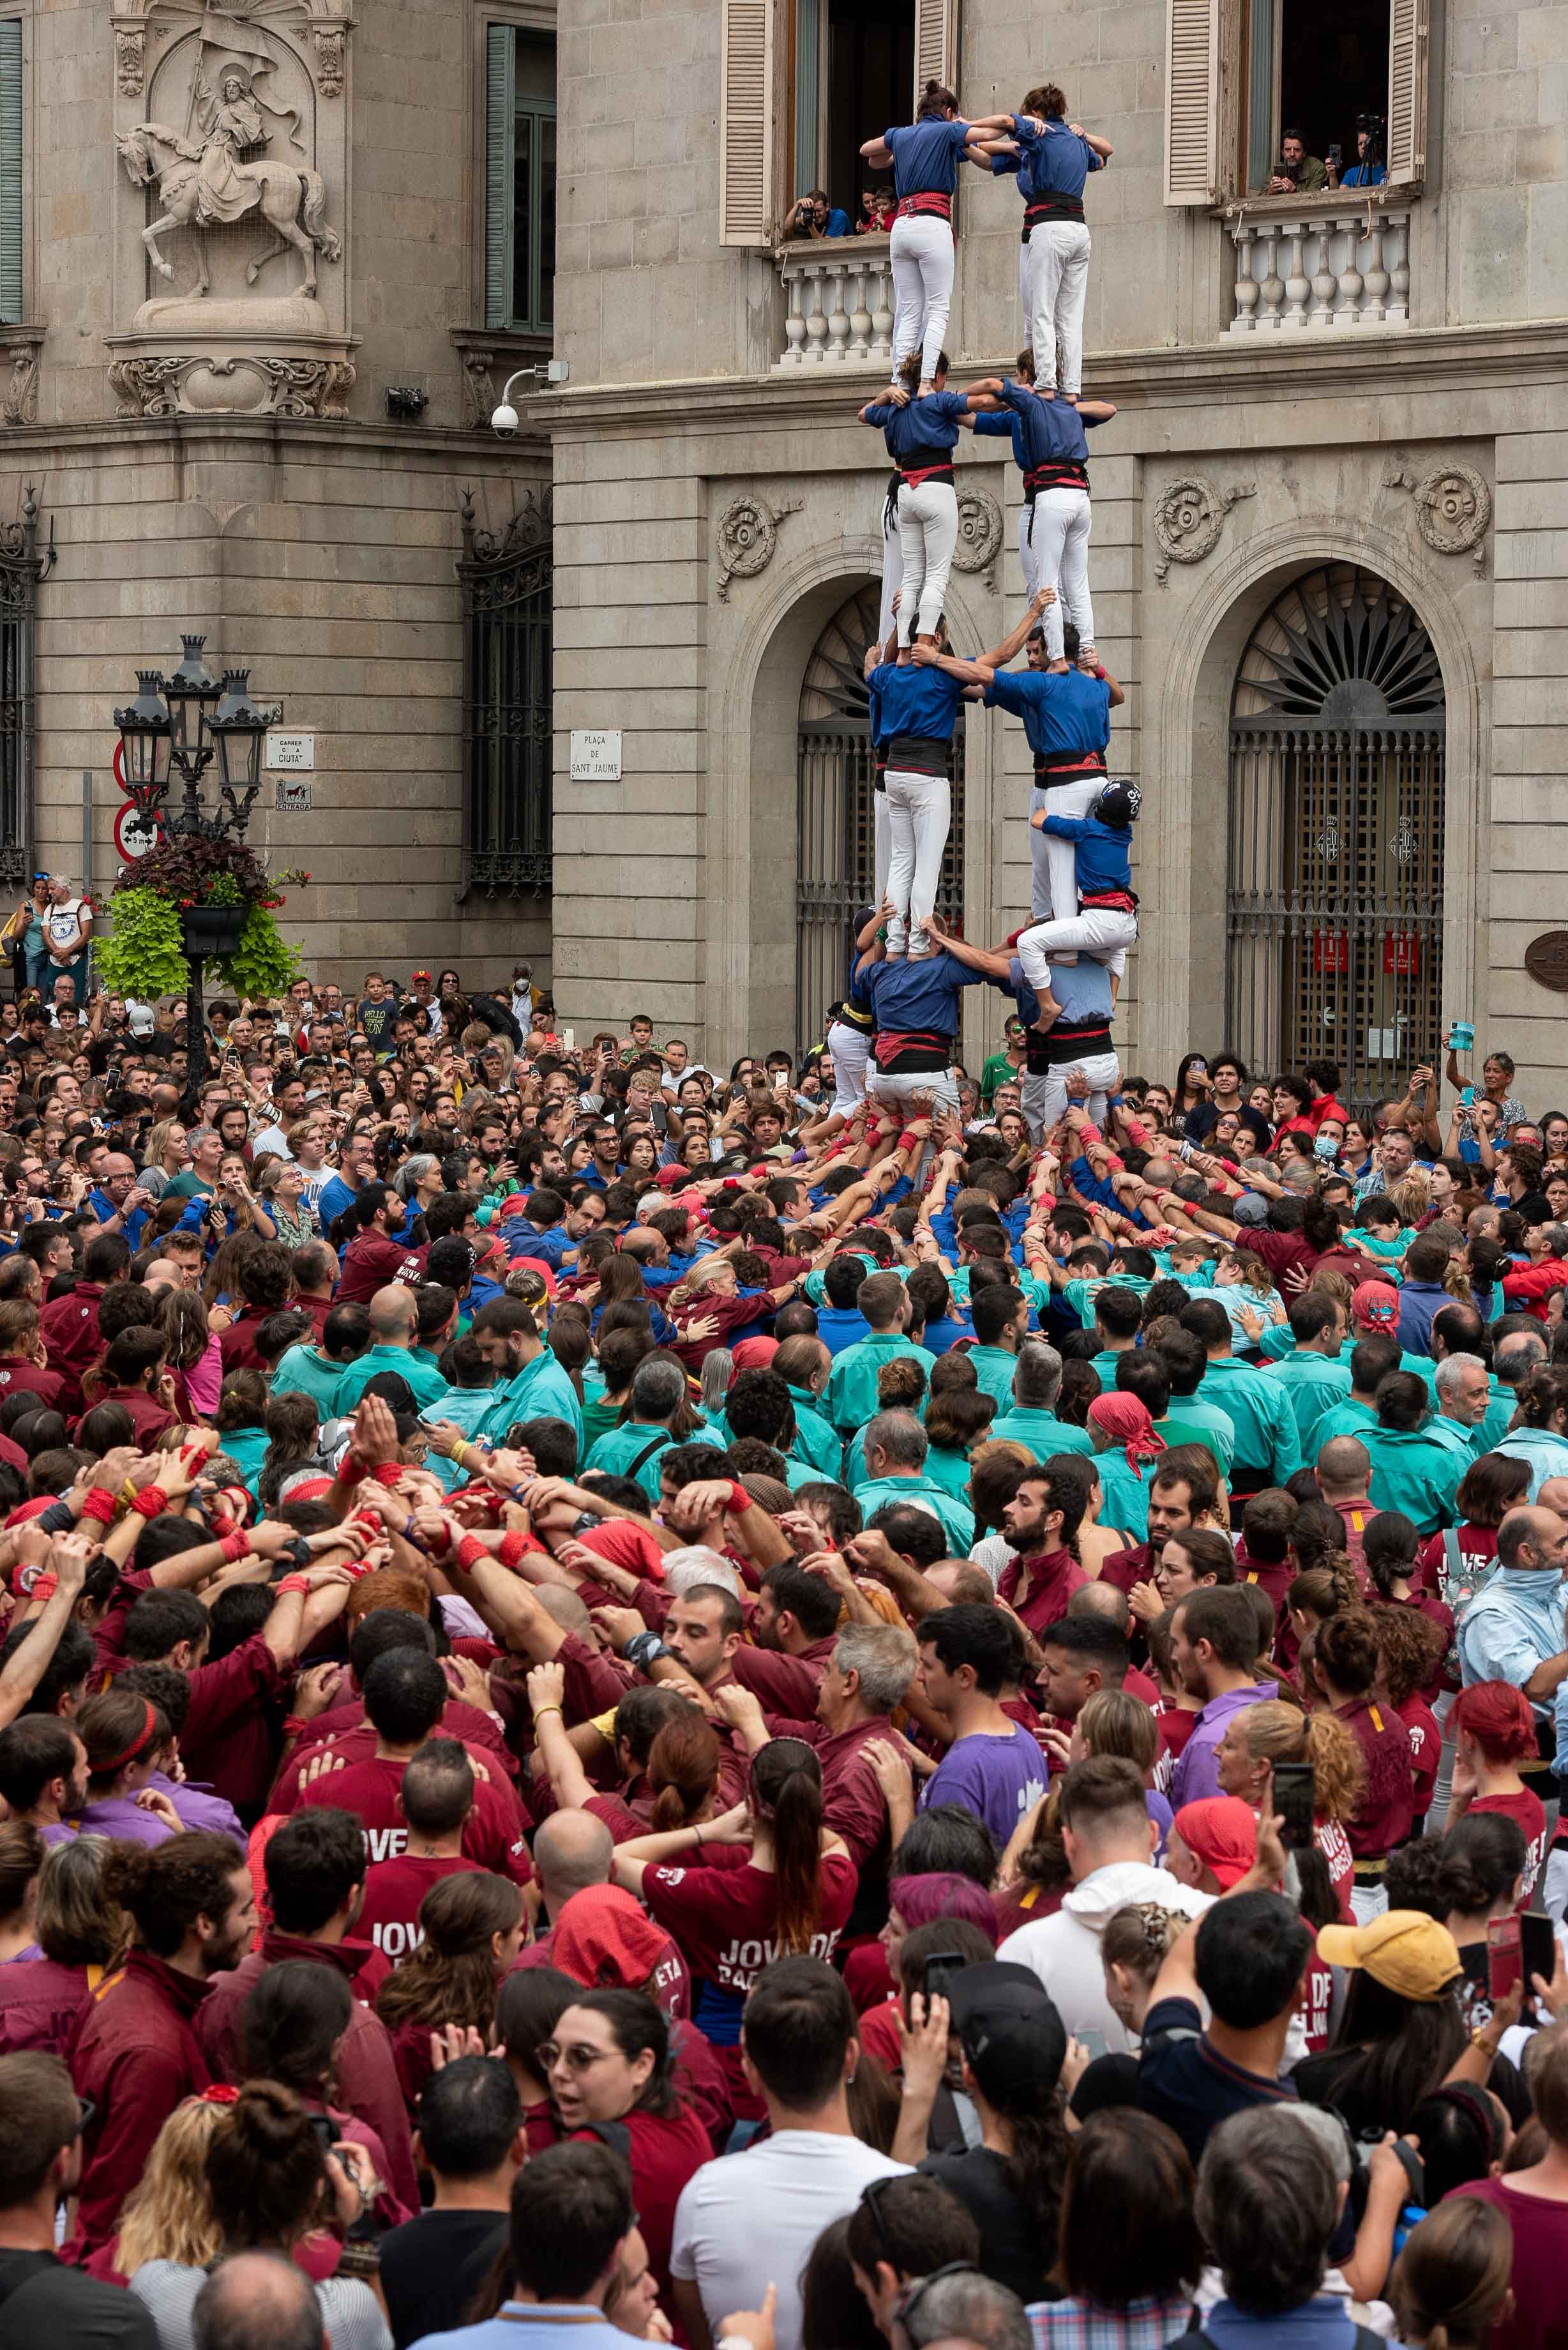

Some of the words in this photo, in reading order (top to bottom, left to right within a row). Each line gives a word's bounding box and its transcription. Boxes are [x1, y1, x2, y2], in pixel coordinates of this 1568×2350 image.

[584, 736, 605, 745] PLAÇA
[279, 754, 303, 762] CIUTAT
[571, 764, 591, 773] SANT
[593, 764, 618, 773] JAUME
[365, 1023, 383, 1035] SUN
[1436, 1552, 1487, 1574] JVE
